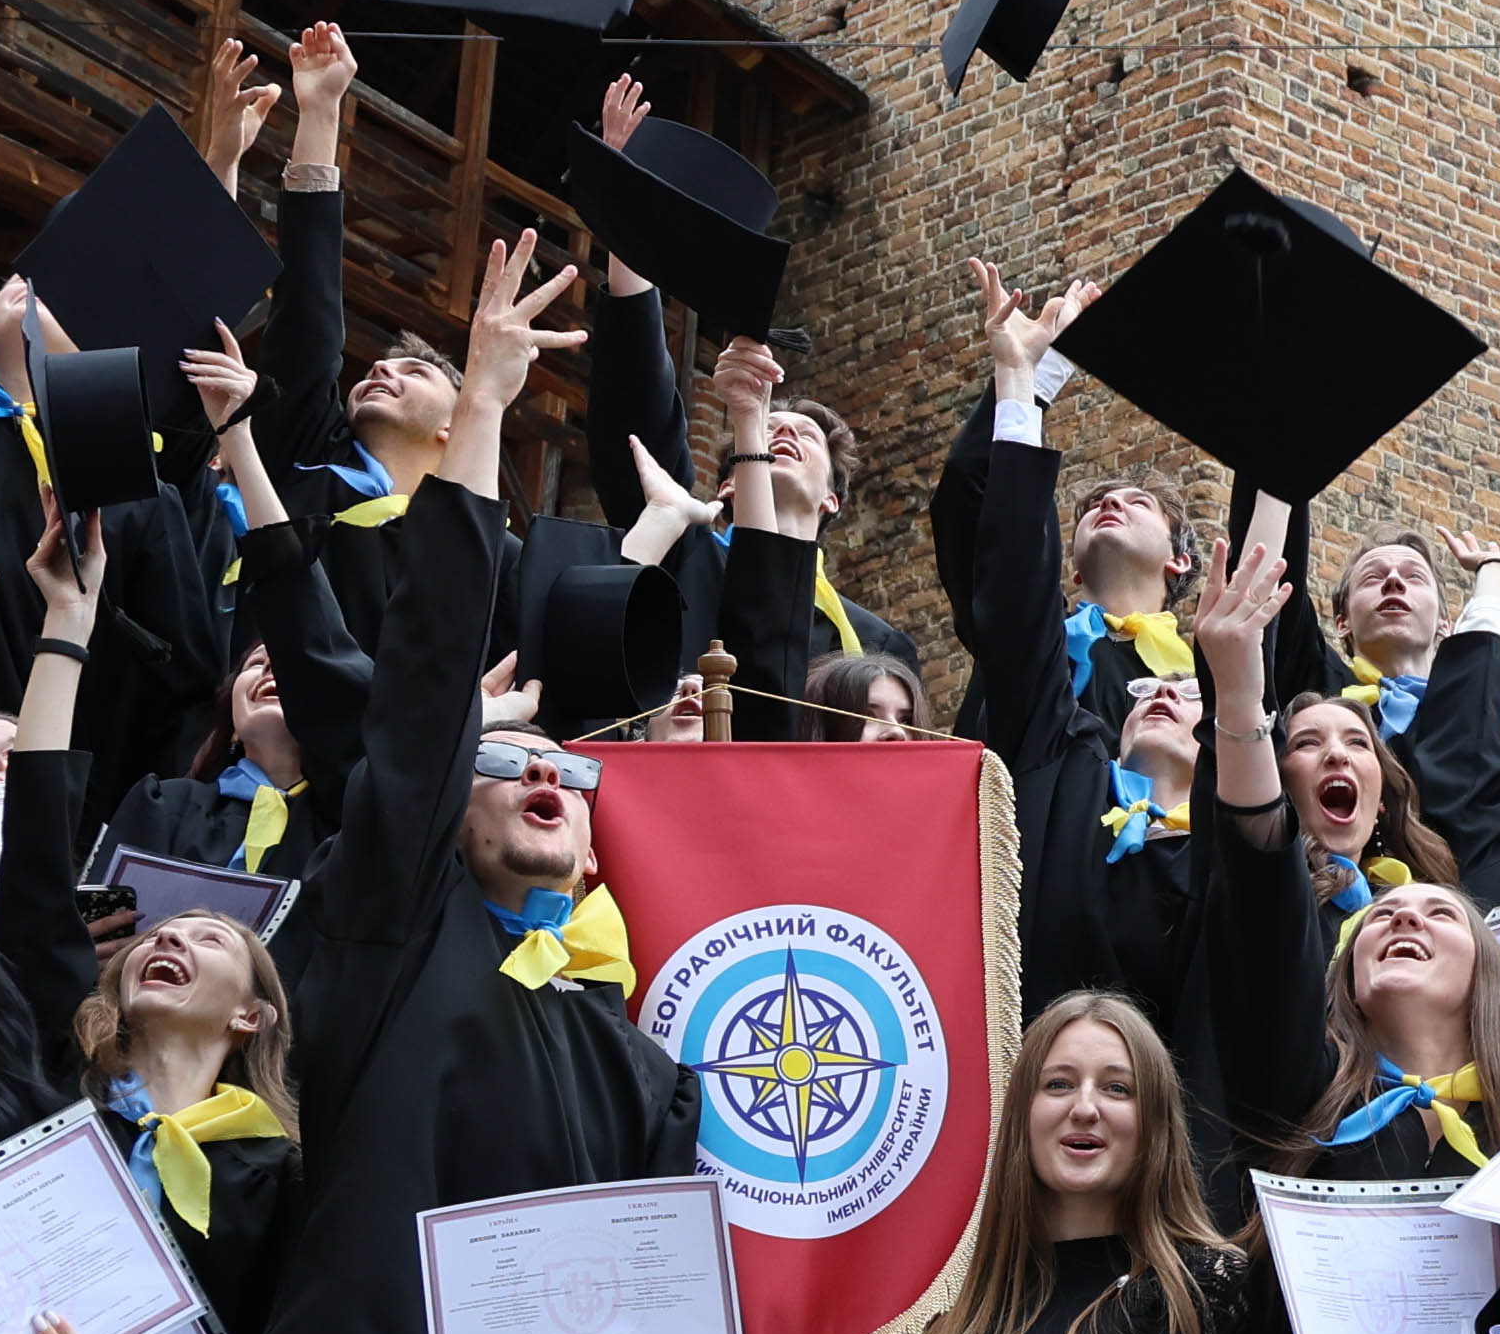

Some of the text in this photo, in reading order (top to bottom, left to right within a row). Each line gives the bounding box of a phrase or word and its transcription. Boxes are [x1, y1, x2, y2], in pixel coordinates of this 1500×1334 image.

[651, 913, 935, 1052] ЕОГРАФІЧНИЙ ФАКУЛЬТЕТ
[724, 1078, 913, 1206] НАЦІОНАЛЬНИЙ УНІВЕРСИТЕТ
[827, 1087, 932, 1224] ІМЕНІ ЛЕСІ УКРАЇНКИ
